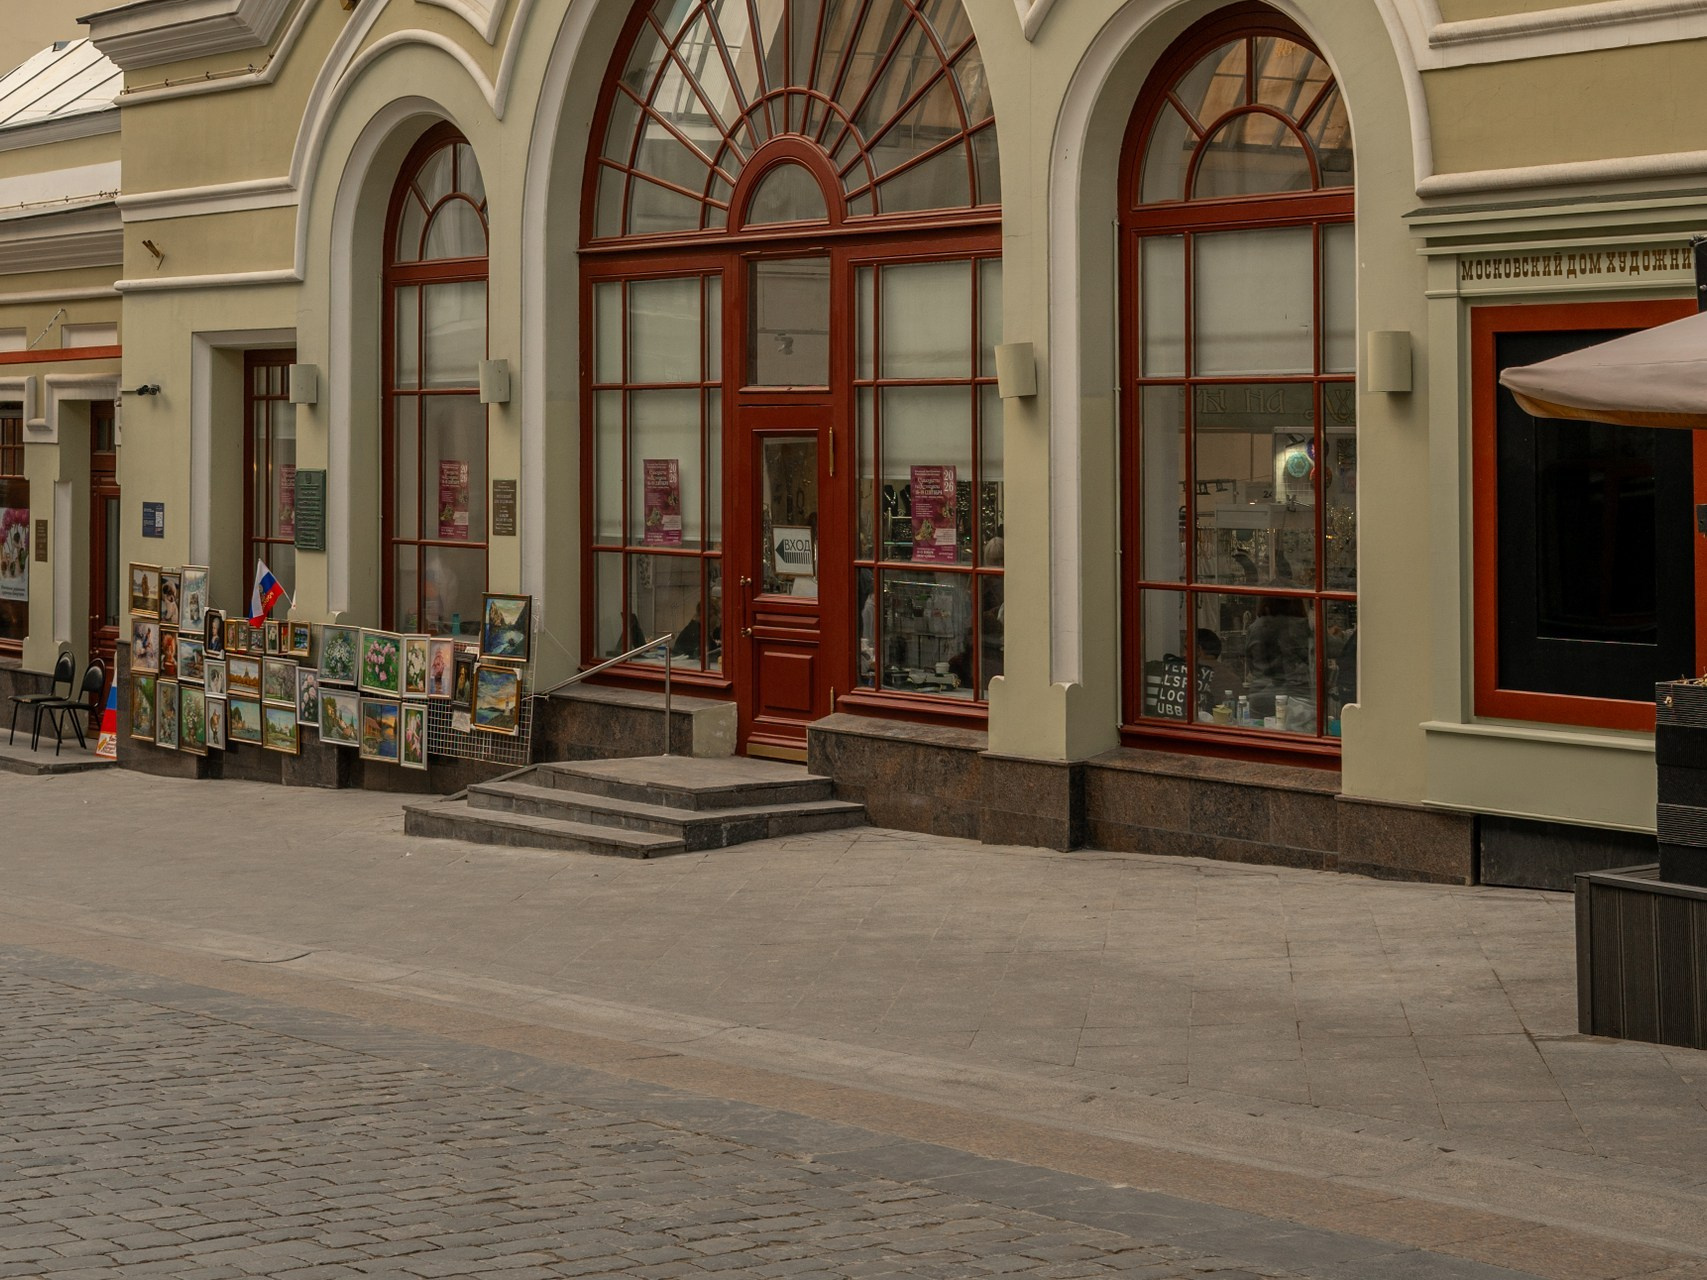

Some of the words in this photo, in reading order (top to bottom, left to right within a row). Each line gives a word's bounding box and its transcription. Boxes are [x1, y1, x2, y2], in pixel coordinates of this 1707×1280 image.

[1461, 251, 1563, 281] МОСКОВСКИЙ
[1566, 252, 1602, 279] ДОМ
[1605, 247, 1696, 276] ХУДОЖНИ
[943, 469, 954, 481] 20
[943, 481, 954, 492] 26
[784, 538, 811, 552] ВХОД
